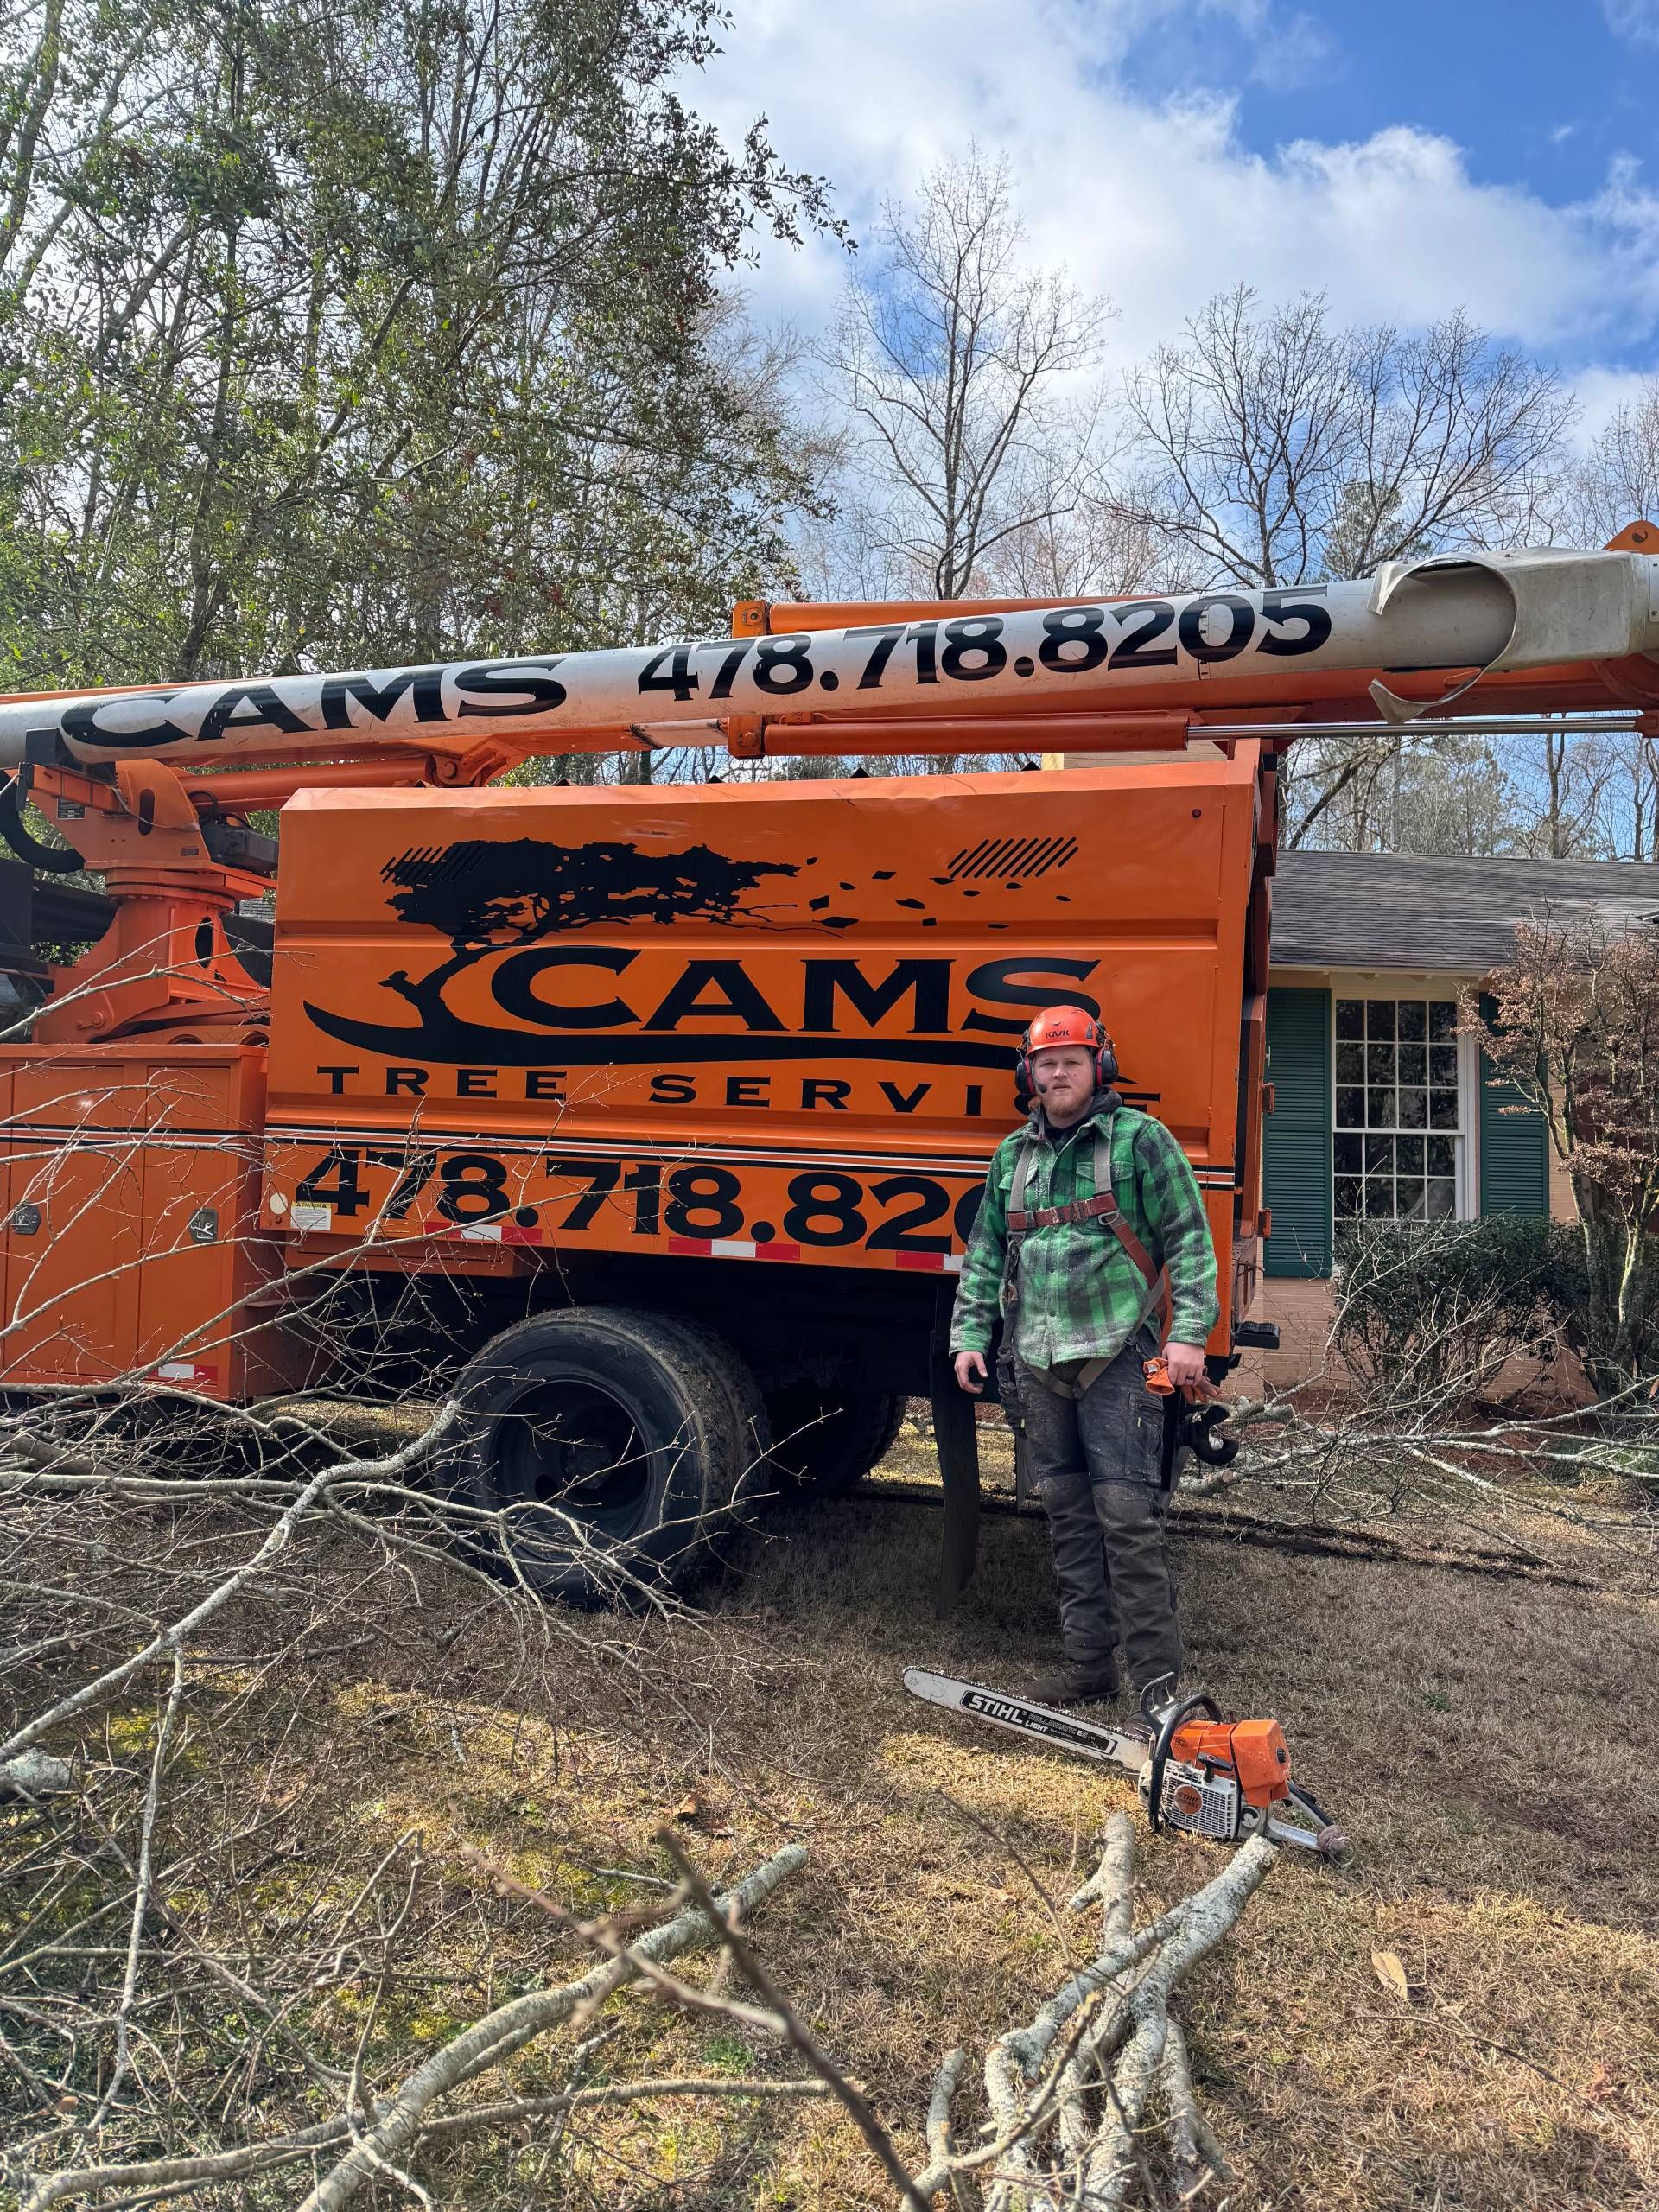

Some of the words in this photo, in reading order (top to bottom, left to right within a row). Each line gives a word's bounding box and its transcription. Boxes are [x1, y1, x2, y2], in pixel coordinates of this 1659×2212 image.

[60, 658, 568, 748] CAMS
[637, 585, 1332, 702] 478.718.8205
[491, 944, 1101, 1036] CAMS
[1046, 1030, 1070, 1039] KASK
[316, 1065, 568, 1102] TREE
[295, 1147, 987, 1257] 478.718.82
[969, 1694, 1024, 1725] STIHL
[1025, 1719, 1049, 1733] LIGHT
